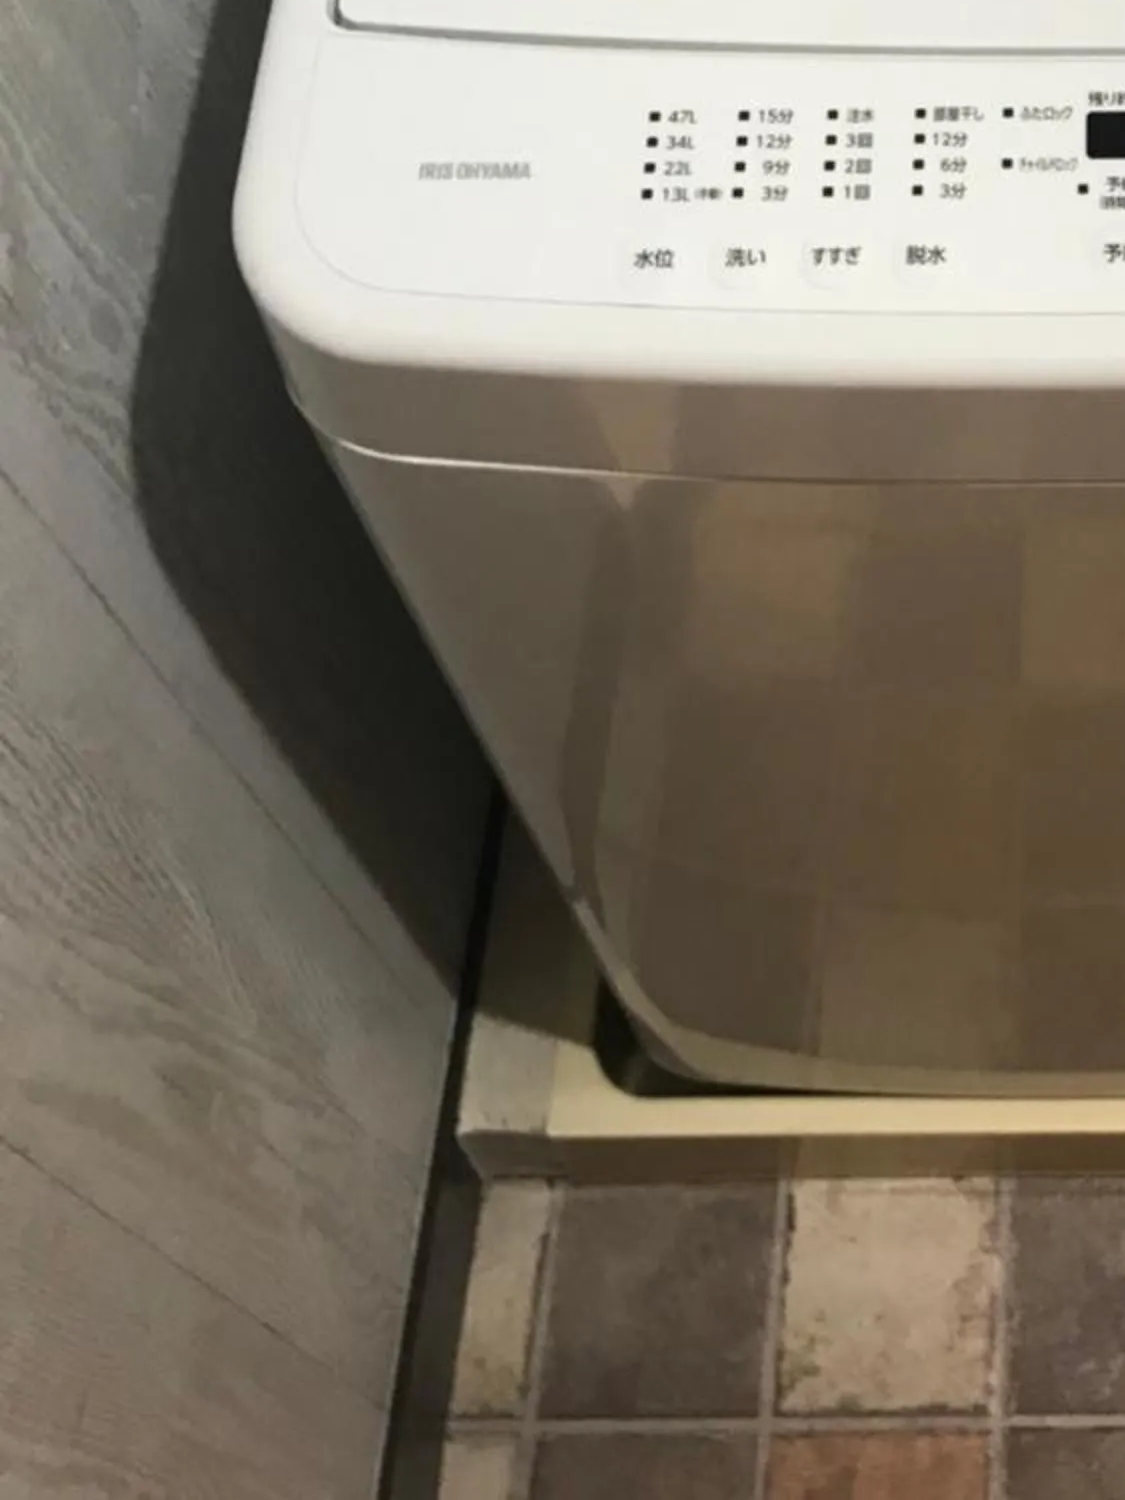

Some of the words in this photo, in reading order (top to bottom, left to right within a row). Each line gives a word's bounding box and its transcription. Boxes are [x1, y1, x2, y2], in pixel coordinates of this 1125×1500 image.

[668, 110, 696, 124] 47L
[758, 108, 794, 125] 15分
[666, 135, 695, 150] 34L
[756, 134, 793, 150] 12分
[933, 132, 968, 148] 12分
[418, 162, 453, 180] IRIS
[455, 162, 532, 180] OHYAMA
[663, 160, 692, 176] 22L
[762, 160, 790, 176] 9分
[940, 157, 967, 173] 6分
[762, 186, 788, 201] 3分
[940, 182, 967, 200] 3分
[634, 249, 674, 268] 水位
[725, 247, 766, 267] 洗い
[812, 247, 861, 266] すすぎ
[906, 245, 946, 265] 脱水
